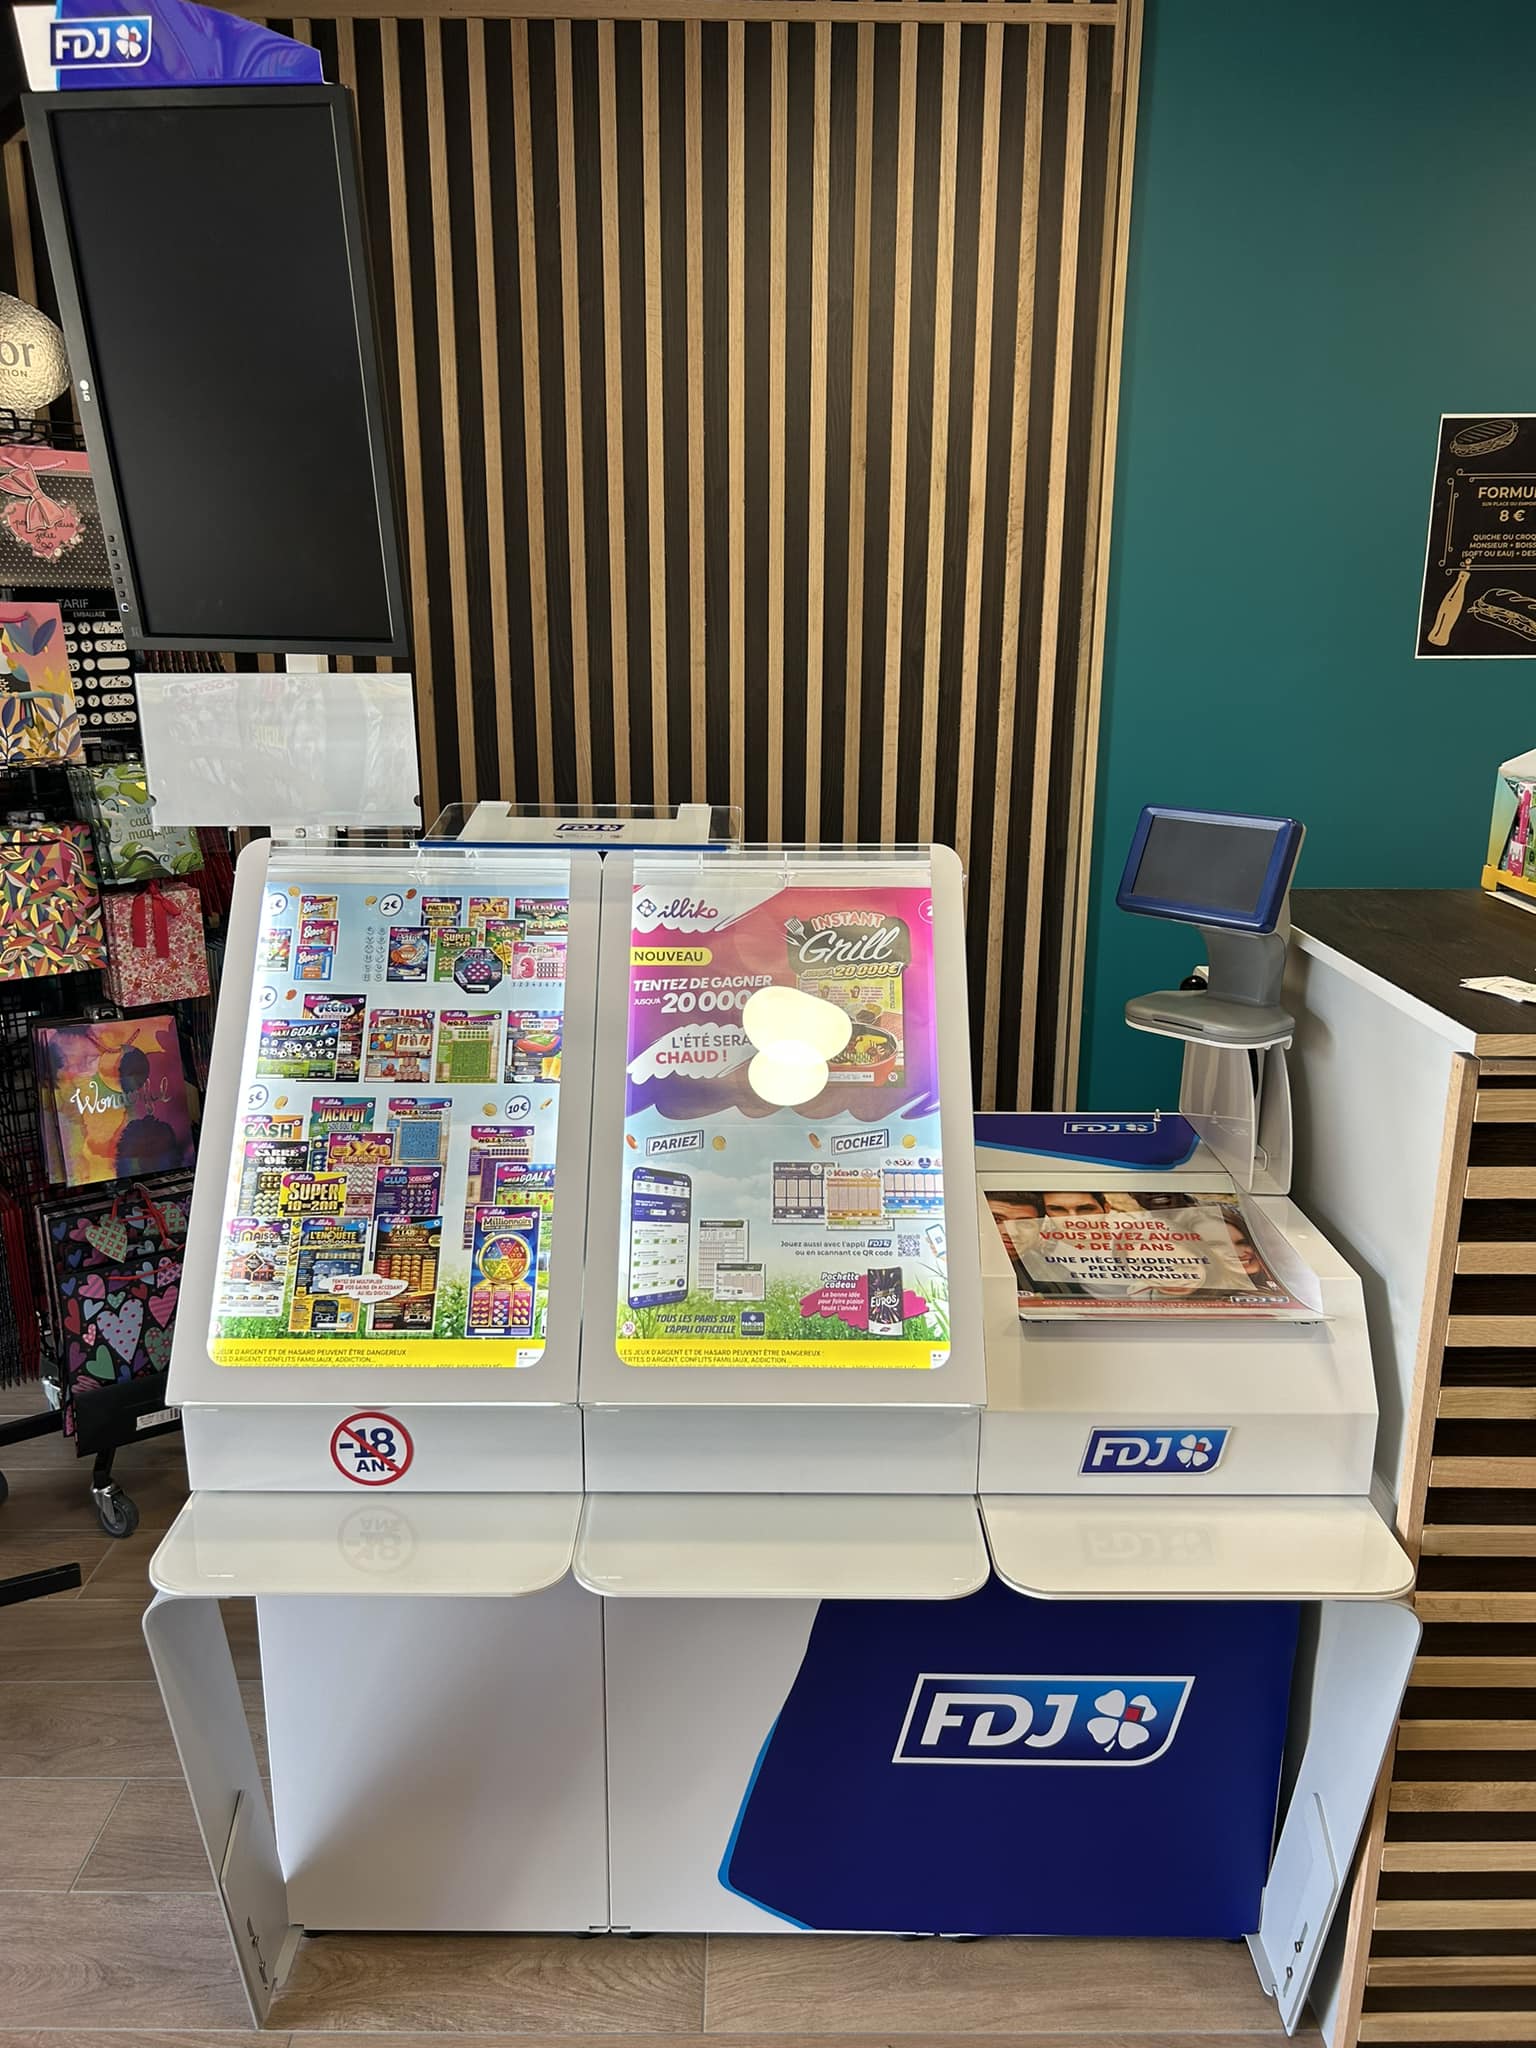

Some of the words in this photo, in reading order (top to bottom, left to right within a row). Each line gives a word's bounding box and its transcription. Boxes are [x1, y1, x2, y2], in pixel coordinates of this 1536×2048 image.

[55, 28, 110, 59] FDJ
[1499, 509, 1510, 522] 8
[1513, 509, 1526, 522] €
[657, 898, 719, 919] illiko
[811, 911, 885, 932] INSTANT
[799, 926, 901, 964] Grill
[634, 950, 704, 963] NOUVEAU
[633, 978, 689, 992] TENTEZ
[690, 977, 710, 989] DE
[710, 975, 773, 988] GAGNER
[671, 1033, 710, 1049] L'ÉTÉ
[713, 1034, 753, 1047] SERA
[655, 1049, 719, 1064] CHAUD
[507, 1102, 528, 1114] 10€
[318, 1108, 367, 1123] JACKPOT
[243, 1123, 293, 1138] CASH
[1071, 1124, 1121, 1132] FDJ
[651, 1135, 698, 1152] PARIEZ
[835, 1134, 884, 1151] COCHEZ
[288, 1181, 339, 1201] SUPER
[1065, 1220, 1110, 1230] POUR
[1114, 1221, 1170, 1231] JOUER,
[1039, 1231, 1087, 1240] VOUS
[1091, 1231, 1145, 1241] DEVEZ
[1149, 1232, 1201, 1241] AVOIR
[781, 1240, 802, 1248] Jouez
[1090, 1242, 1113, 1251] DE
[1116, 1242, 1135, 1251] 18
[1140, 1242, 1175, 1251] ANS
[862, 1249, 874, 1257] QR
[1045, 1256, 1077, 1264] UNE
[1126, 1255, 1211, 1265] D'IDENTITÉ
[1070, 1271, 1108, 1279] ÊTRE
[1112, 1271, 1201, 1280] DEMANDÉE
[1131, 1265, 1175, 1273] VOUS
[822, 1272, 860, 1281] Pochette
[825, 1280, 857, 1289] cadeau
[656, 1314, 678, 1323] TOUS
[679, 1314, 694, 1323] LES
[695, 1314, 718, 1323] PARIS
[719, 1314, 737, 1324] SUR
[695, 1325, 737, 1334] OFFICIELLE
[339, 1427, 397, 1459] -18
[1091, 1437, 1173, 1467] FDJ
[920, 1692, 1079, 1748] FDJ
